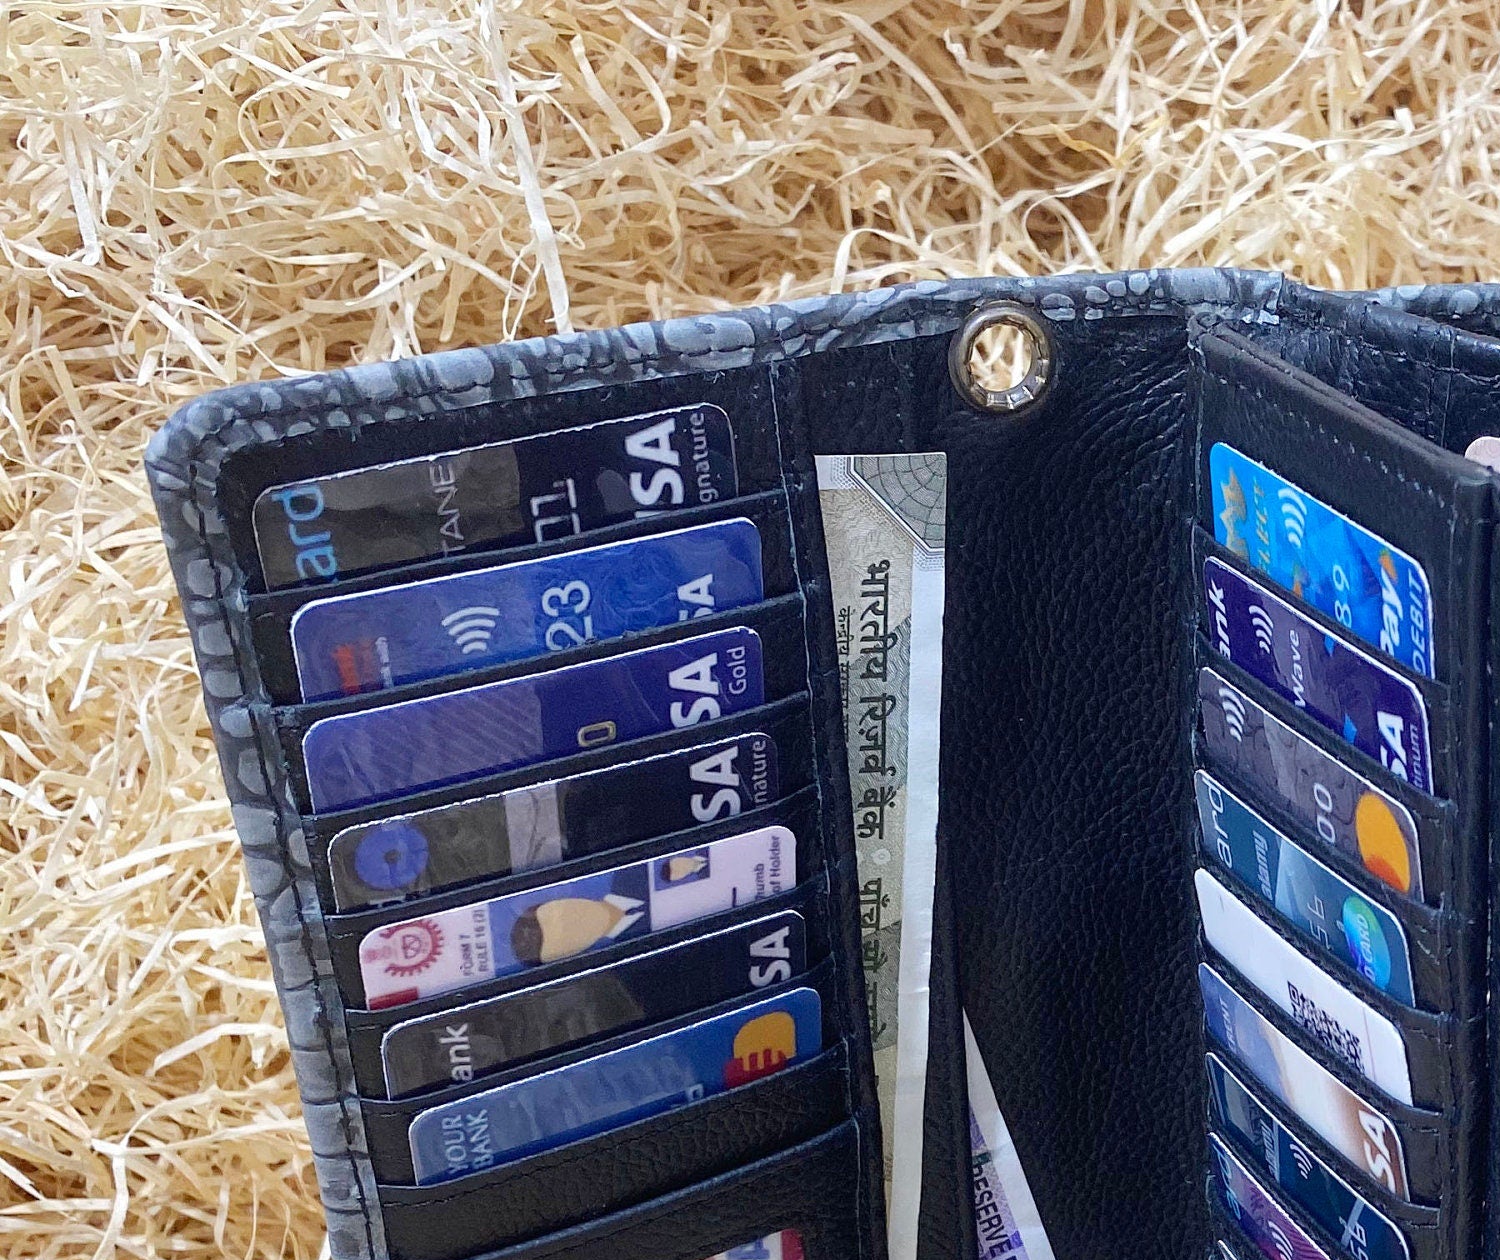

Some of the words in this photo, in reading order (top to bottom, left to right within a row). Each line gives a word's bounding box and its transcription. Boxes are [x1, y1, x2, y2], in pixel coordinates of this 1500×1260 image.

[542, 580, 592, 651] 23
[860, 560, 897, 682] भारतीय
[1407, 569, 1426, 674] DEBIT
[727, 645, 748, 695] Gold
[689, 746, 741, 822] SA
[856, 786, 896, 839] बैंक
[1203, 778, 1232, 869] ard
[770, 836, 782, 877] Holder
[749, 926, 791, 988] SA
[441, 1115, 469, 1173] YOUR
[466, 1109, 495, 1171] BANK
